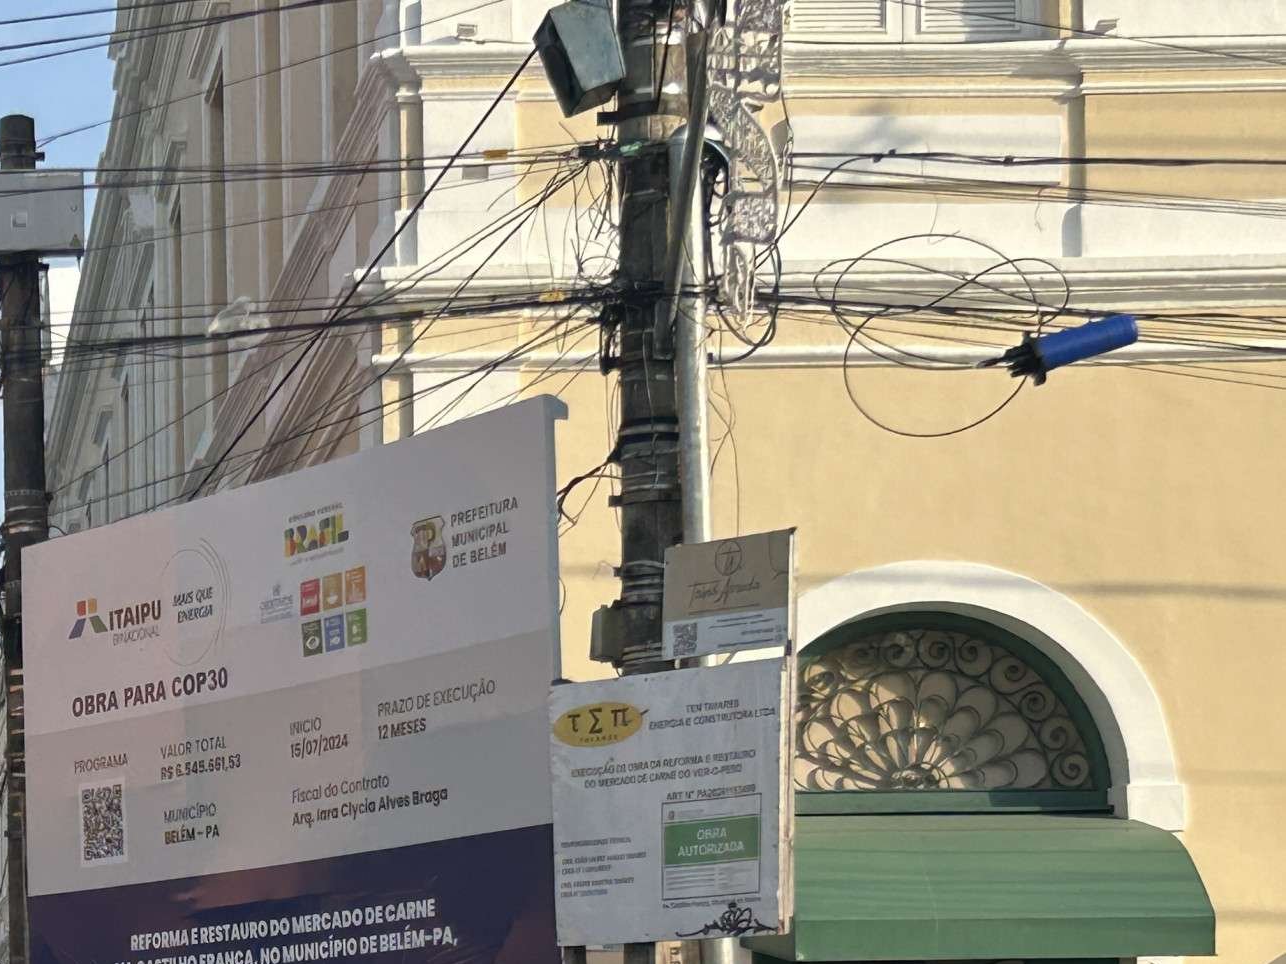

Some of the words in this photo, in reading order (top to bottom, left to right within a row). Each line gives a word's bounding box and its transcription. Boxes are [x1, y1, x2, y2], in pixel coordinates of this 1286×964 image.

[450, 496, 518, 528] PREFEITURA
[283, 512, 350, 559] BRASIL
[451, 521, 510, 547] MUNICIPAL
[452, 552, 467, 568] DE
[470, 541, 507, 564] BELÉM
[195, 586, 214, 604] QUE
[109, 600, 162, 631] ITAIPU
[72, 690, 119, 718] OBRA
[124, 680, 167, 708] PARA
[172, 666, 229, 698] COP30
[377, 696, 414, 718] PRAZO
[416, 692, 431, 711] DE
[433, 678, 496, 707] EXECUÇÃO
[377, 724, 389, 741] 12
[390, 717, 427, 739] MESES
[160, 741, 192, 760] VALOR
[195, 735, 227, 754] TOTAL
[290, 733, 349, 760] 15/07/2024
[74, 753, 129, 775] PROGRAMA
[291, 784, 322, 805] Fiscal
[324, 781, 339, 798] do
[340, 774, 390, 796] Contrato
[164, 803, 217, 824] MUNICÍPIO
[291, 810, 315, 829] Arq.
[316, 805, 339, 822] Iara
[378, 795, 411, 812] Alves
[411, 787, 449, 808] Braga
[164, 825, 196, 845] BELÉM
[205, 824, 221, 839] PA
[696, 825, 727, 841] OBRA
[677, 840, 746, 858] AUTORIZADA
[130, 928, 189, 951] REFORMA
[190, 926, 199, 945] E
[199, 919, 268, 944] RESTAURO
[270, 917, 290, 937] DO
[291, 908, 364, 935] MERCADO
[365, 905, 384, 926] DE
[385, 898, 436, 922] CARNE
[282, 934, 358, 964] MUNICÍPIO
[359, 934, 379, 955] DE
